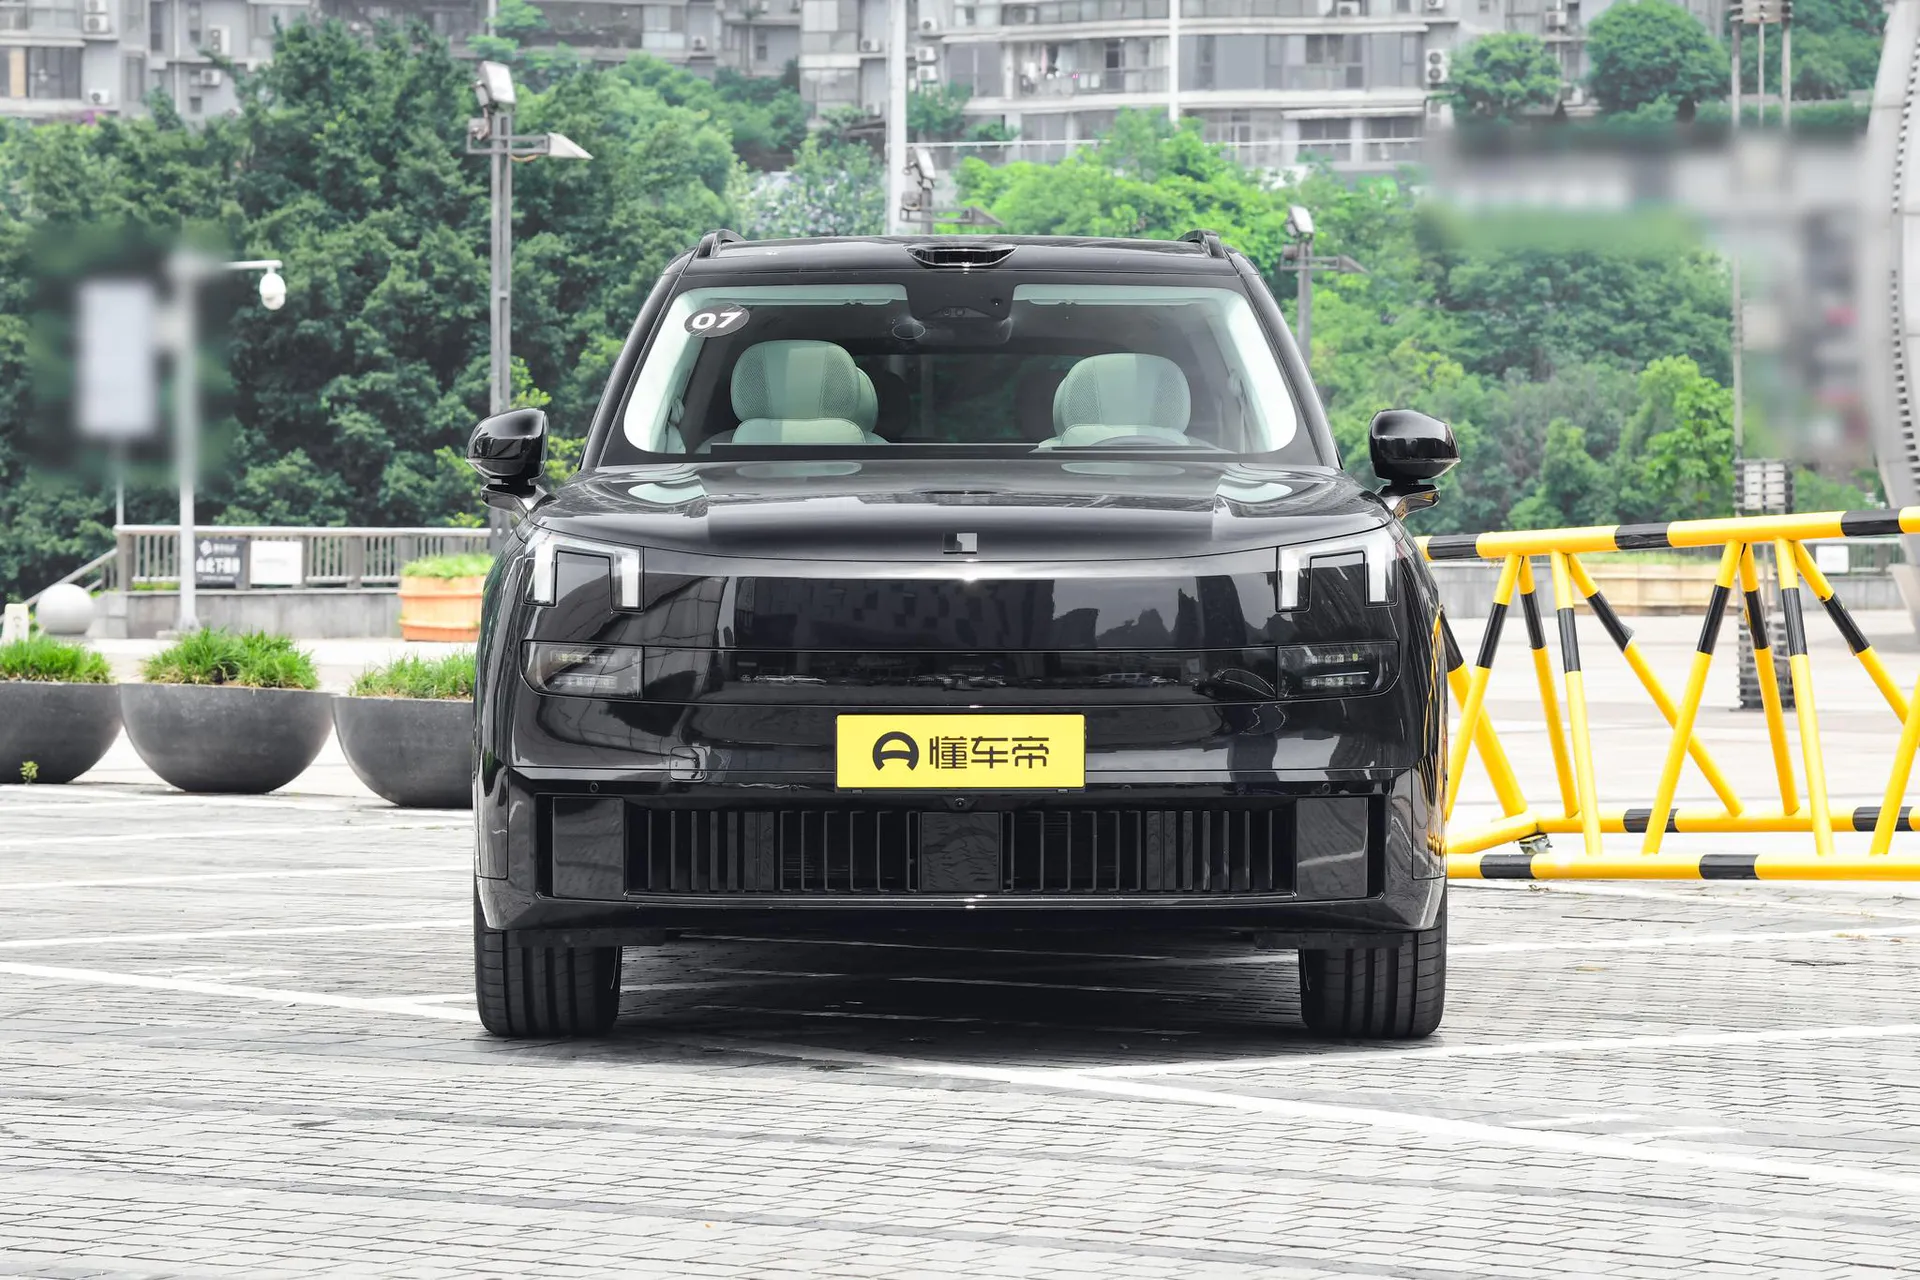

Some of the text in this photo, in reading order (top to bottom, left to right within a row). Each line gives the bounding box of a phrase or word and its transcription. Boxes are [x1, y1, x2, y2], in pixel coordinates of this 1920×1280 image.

[692, 312, 743, 329] 07
[929, 736, 1049, 769] 懂车帝
